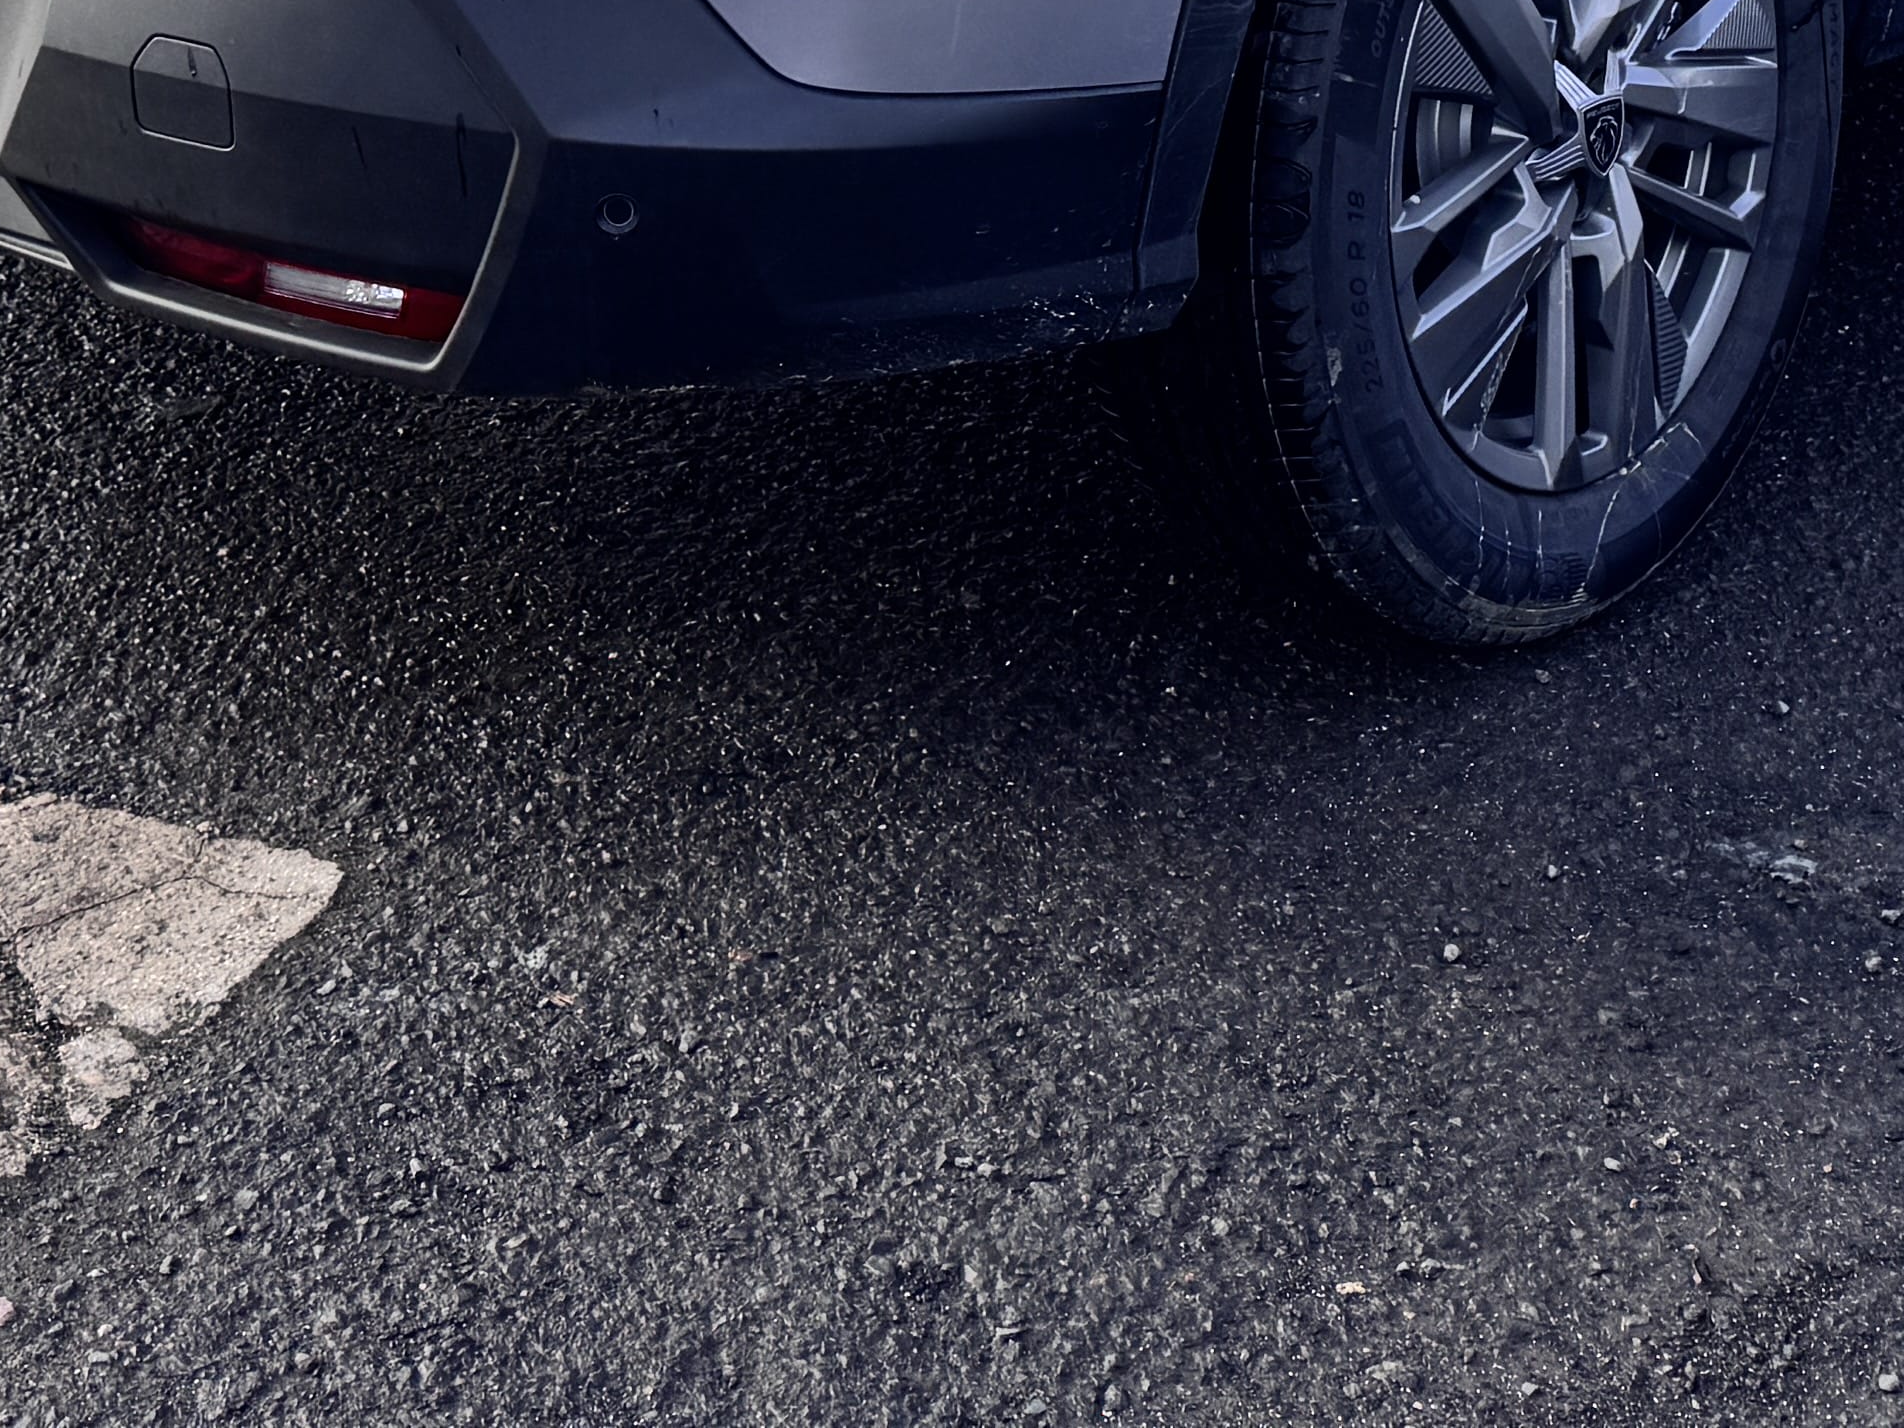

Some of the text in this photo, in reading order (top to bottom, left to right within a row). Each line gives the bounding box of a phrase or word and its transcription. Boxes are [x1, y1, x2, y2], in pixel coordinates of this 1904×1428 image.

[1345, 189, 1387, 395] 225/60 R 18
